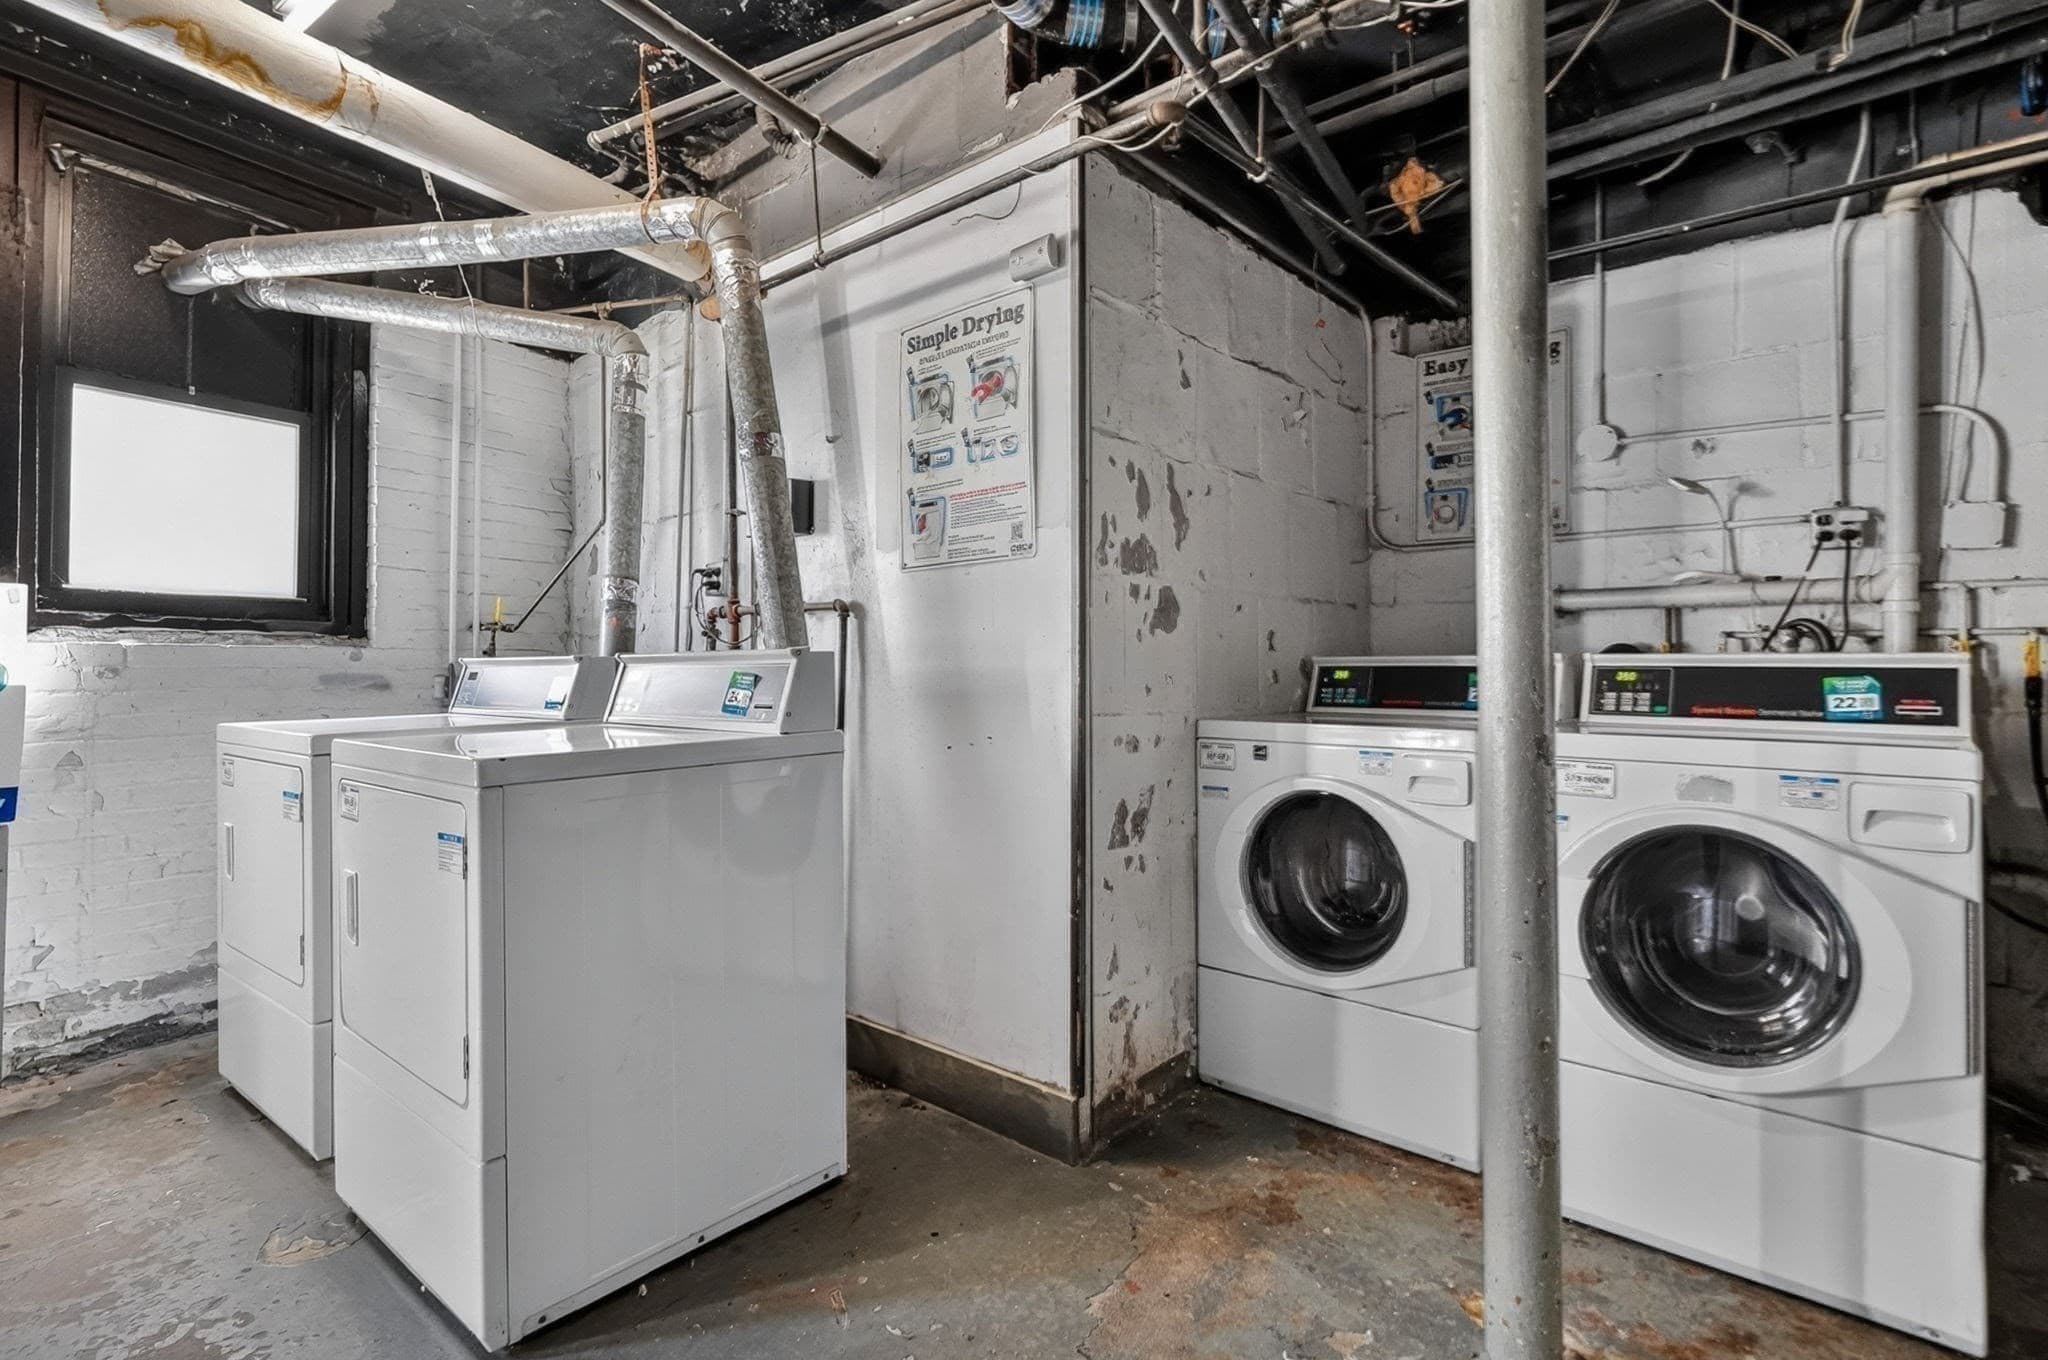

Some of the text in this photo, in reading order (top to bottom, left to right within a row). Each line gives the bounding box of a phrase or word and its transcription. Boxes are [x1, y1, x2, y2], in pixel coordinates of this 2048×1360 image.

[906, 323, 958, 355] Simple
[962, 303, 1025, 335] Drying
[1423, 358, 1468, 376] Easy
[1832, 696, 1857, 708] 22
